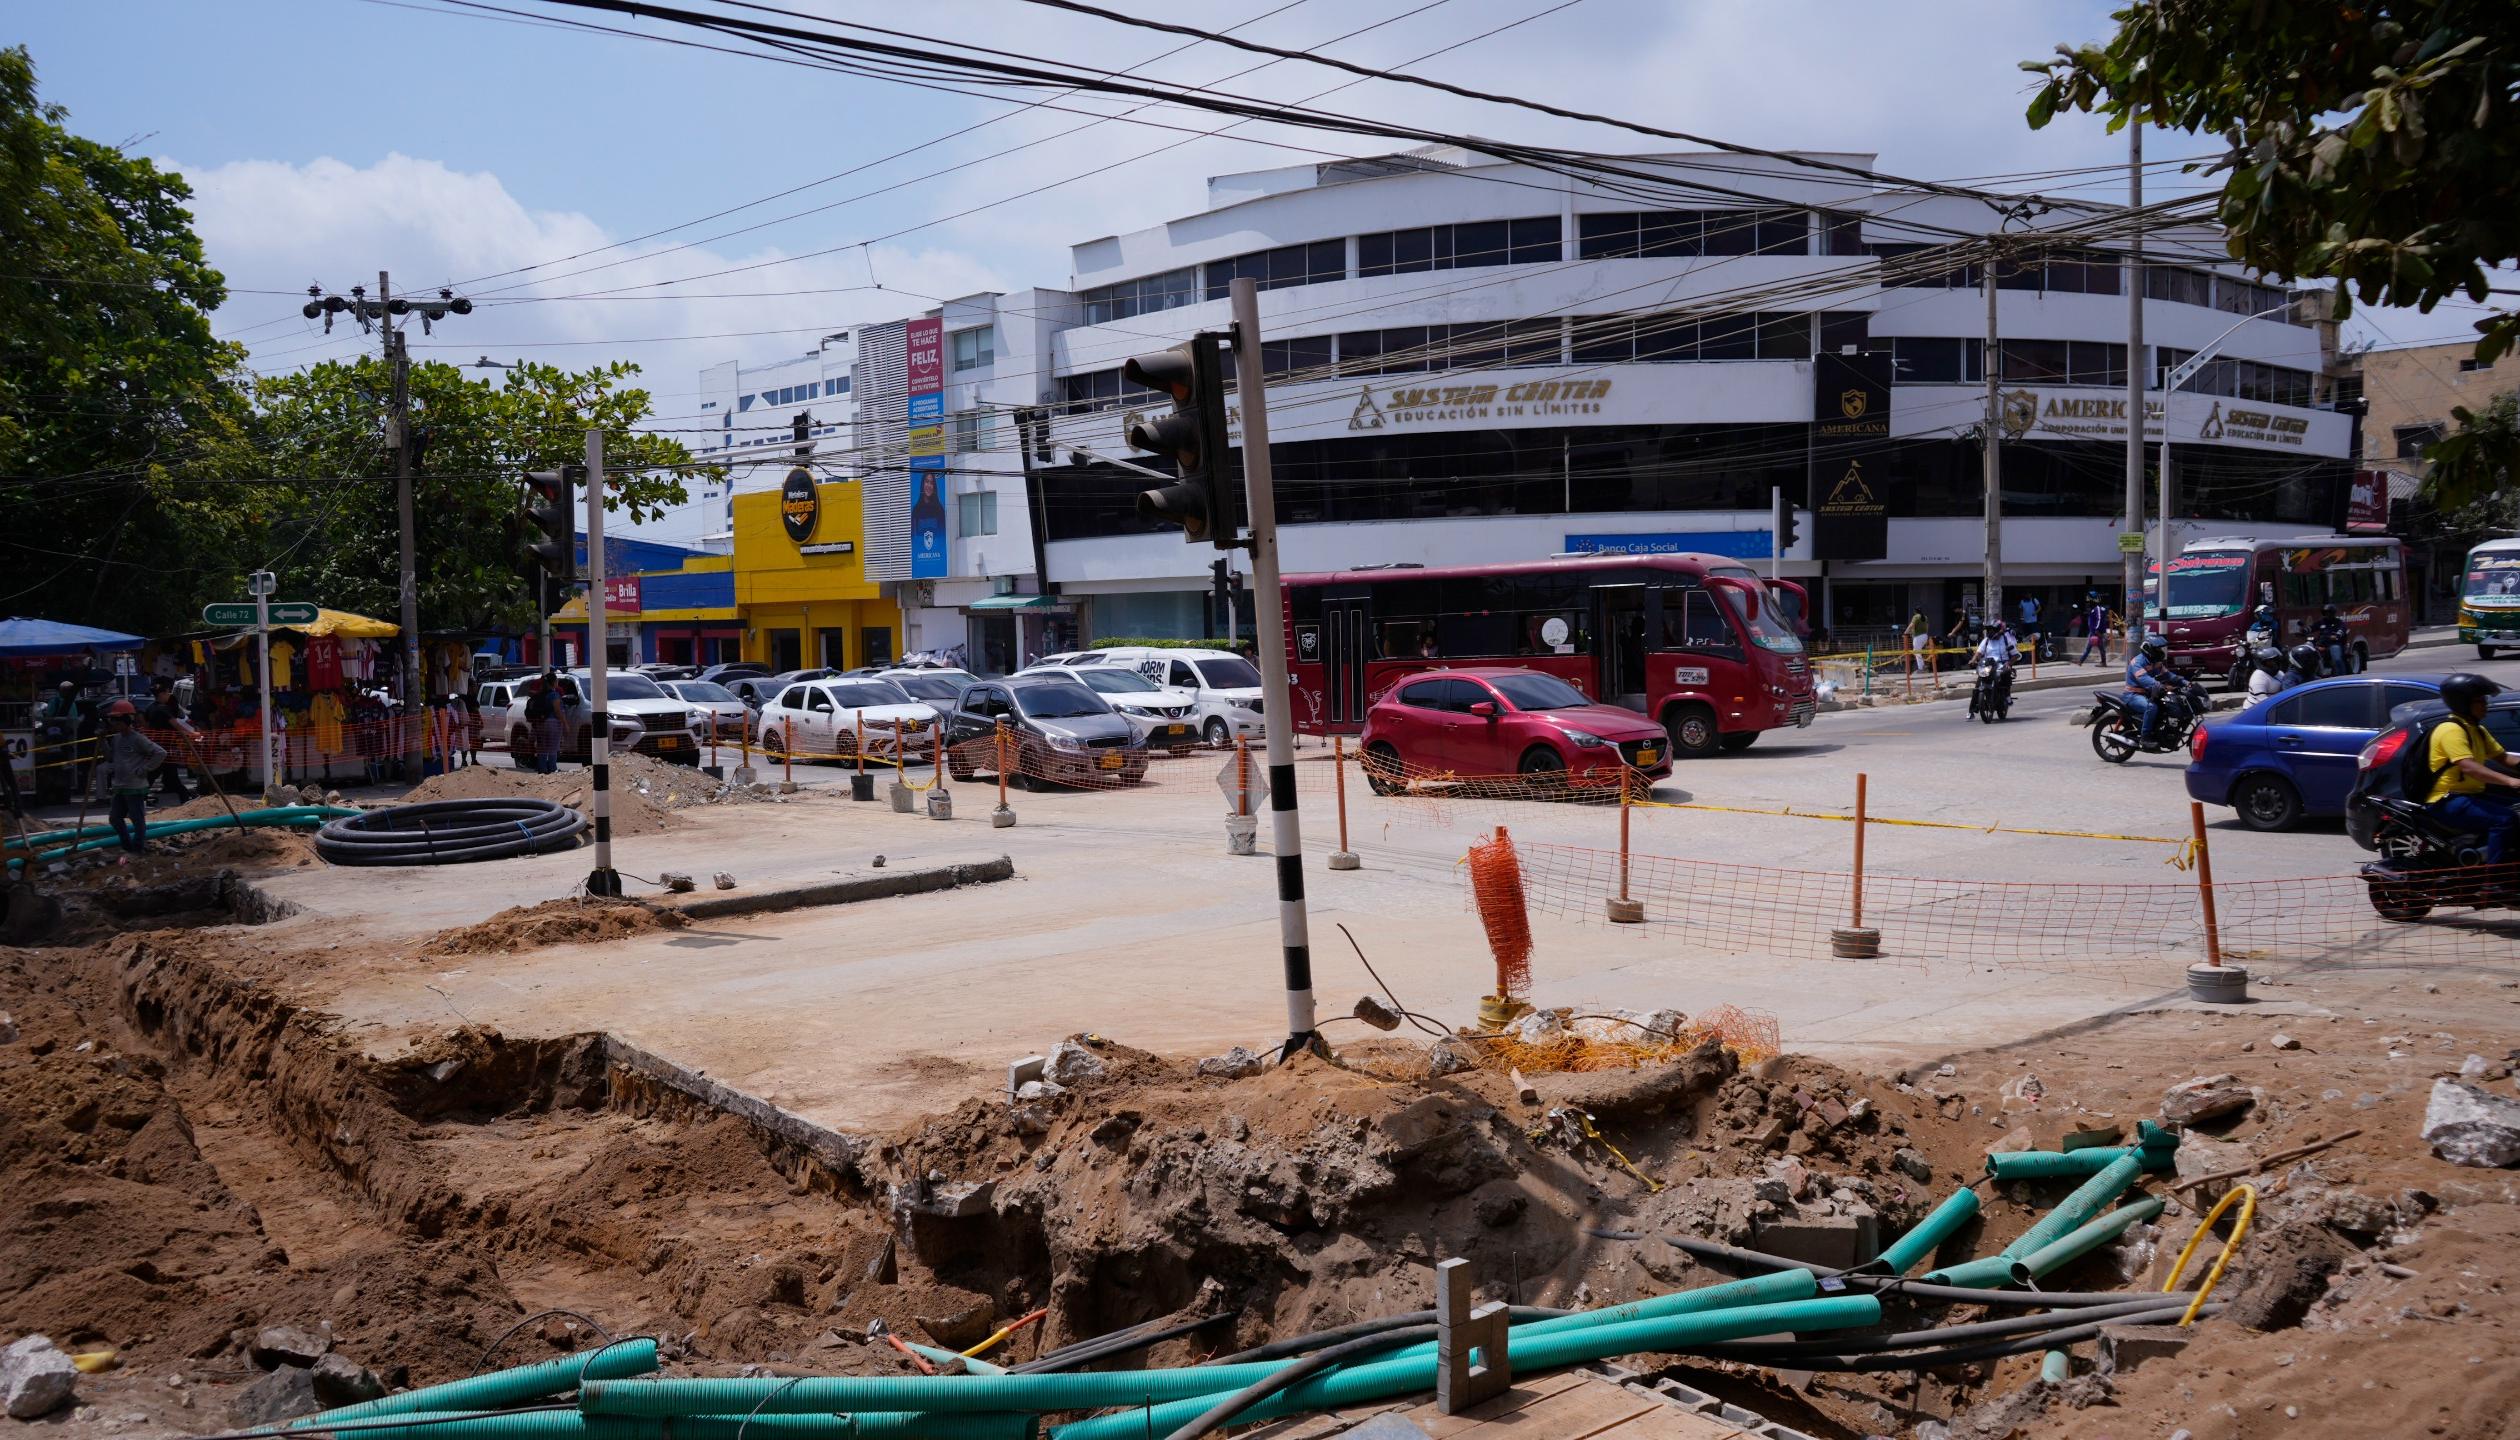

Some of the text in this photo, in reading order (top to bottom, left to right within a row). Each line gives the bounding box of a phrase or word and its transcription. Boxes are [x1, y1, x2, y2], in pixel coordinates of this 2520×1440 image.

[912, 335, 937, 347] TE HACE
[911, 349, 939, 367] FELIZ,
[1505, 379, 1613, 402] CENTER
[1394, 399, 1601, 423] EDUCACIÓN SIN LÍMITES
[1820, 424, 1888, 434] AMERICANA
[2042, 423, 2108, 435] CORPORACIÓN
[783, 500, 815, 514] Maderas
[1598, 542, 1678, 553] Banco Caja Social
[618, 584, 637, 597] Brilla
[215, 610, 249, 620] Calle 72
[314, 644, 332, 664] 14
